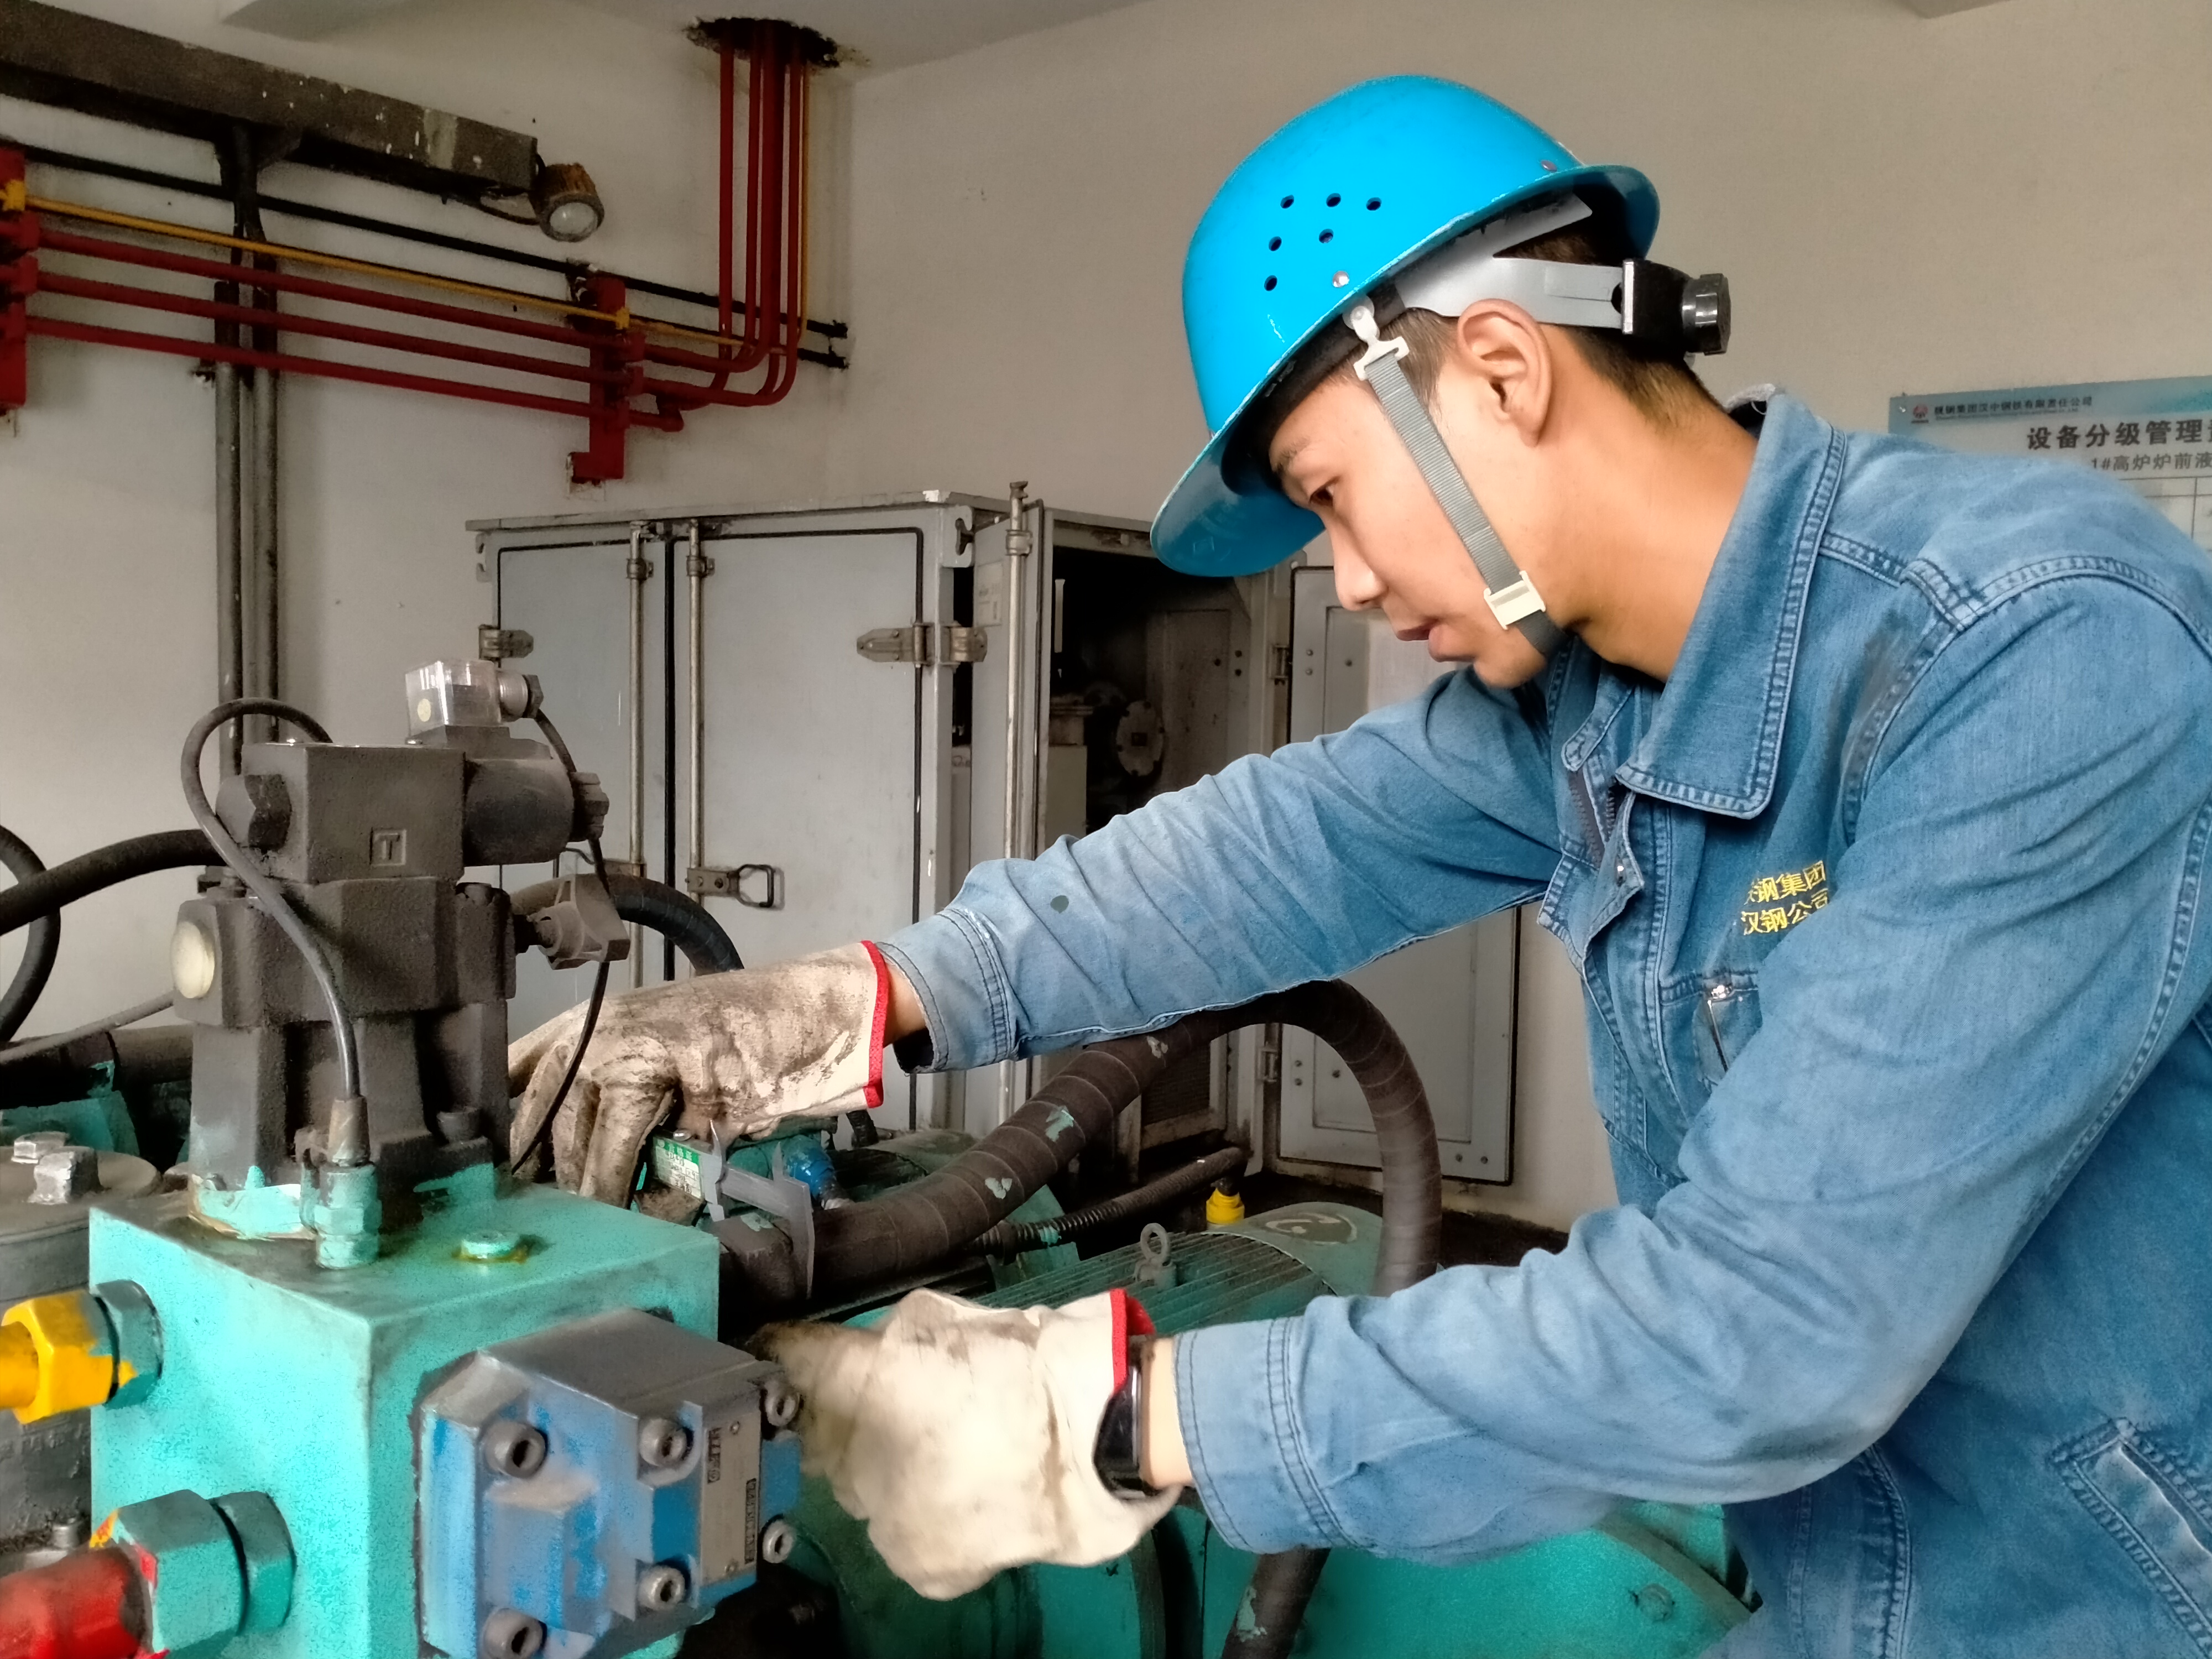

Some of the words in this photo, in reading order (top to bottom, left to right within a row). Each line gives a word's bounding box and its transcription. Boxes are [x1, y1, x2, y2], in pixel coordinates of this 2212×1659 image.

[2027, 419, 2212, 450] 设备分级管理
